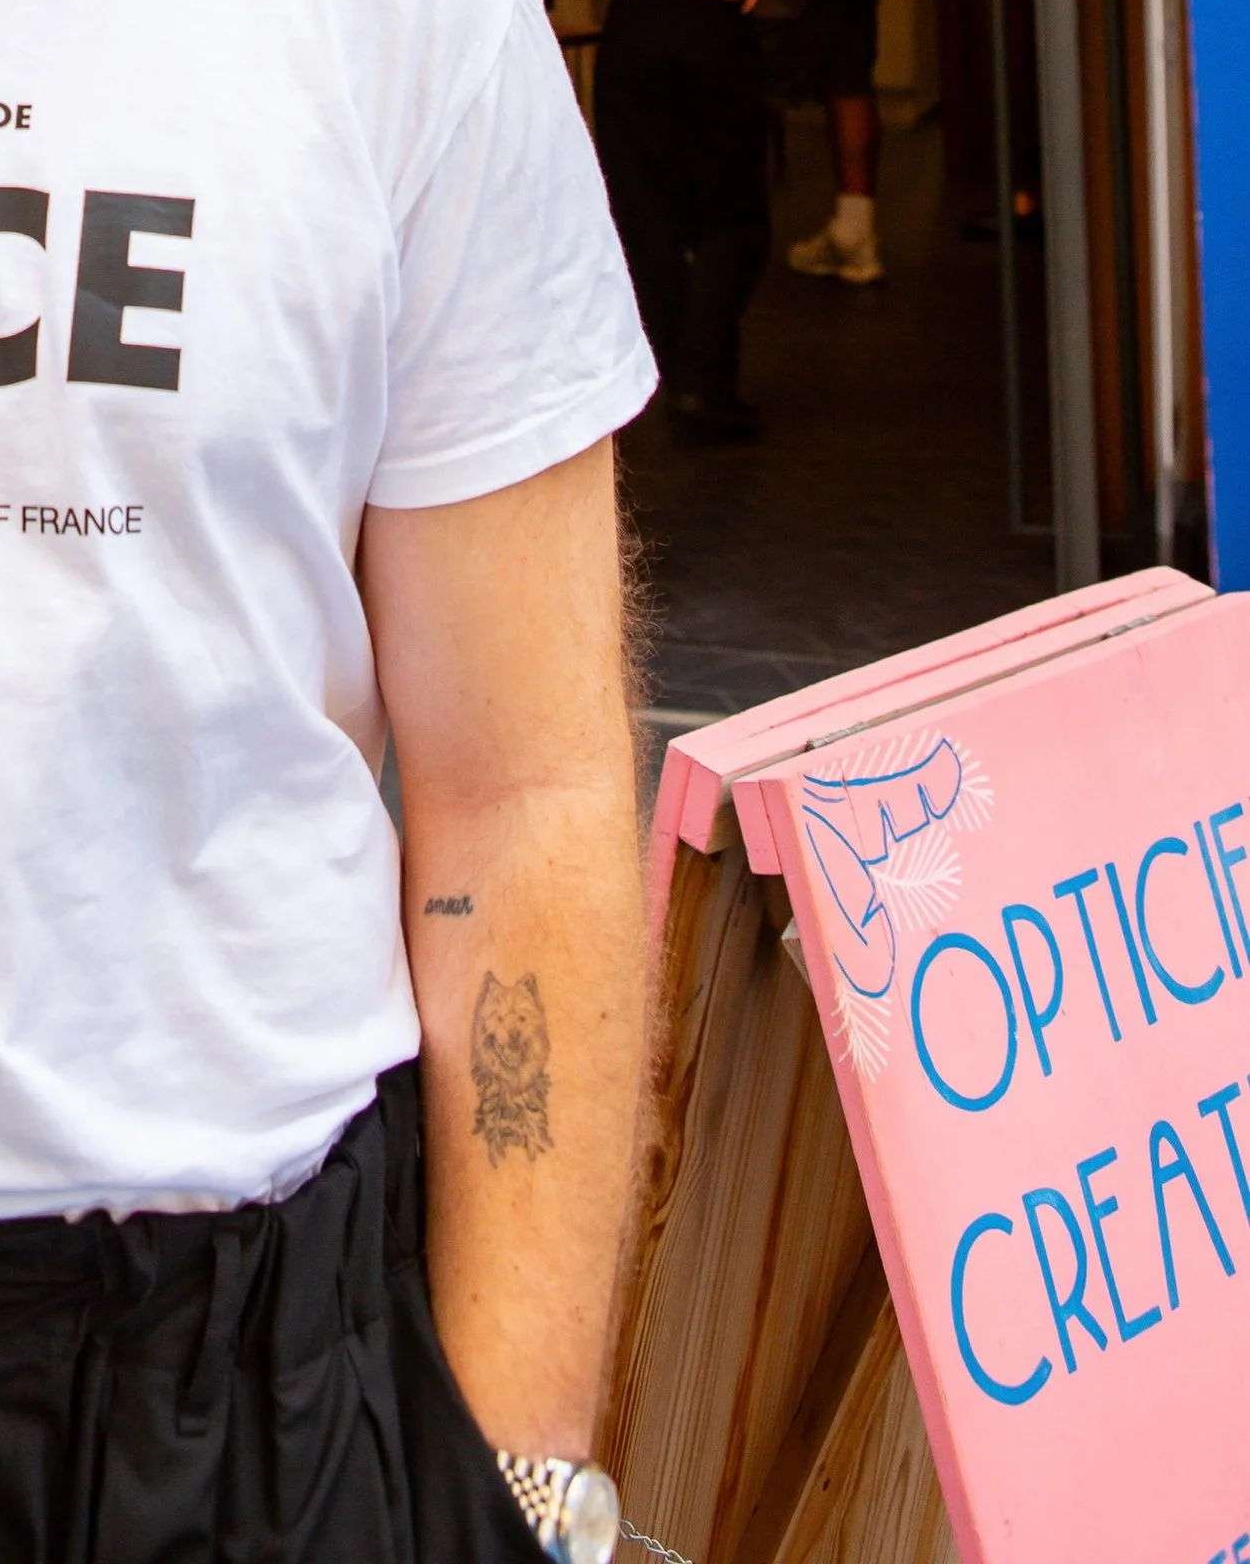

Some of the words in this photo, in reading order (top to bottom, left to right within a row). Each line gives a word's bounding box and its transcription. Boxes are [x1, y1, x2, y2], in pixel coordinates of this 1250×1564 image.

[21, 505, 144, 537] FRANCE
[910, 798, 1250, 1113] OPTICIE
[951, 1074, 1250, 1407] CREAT
